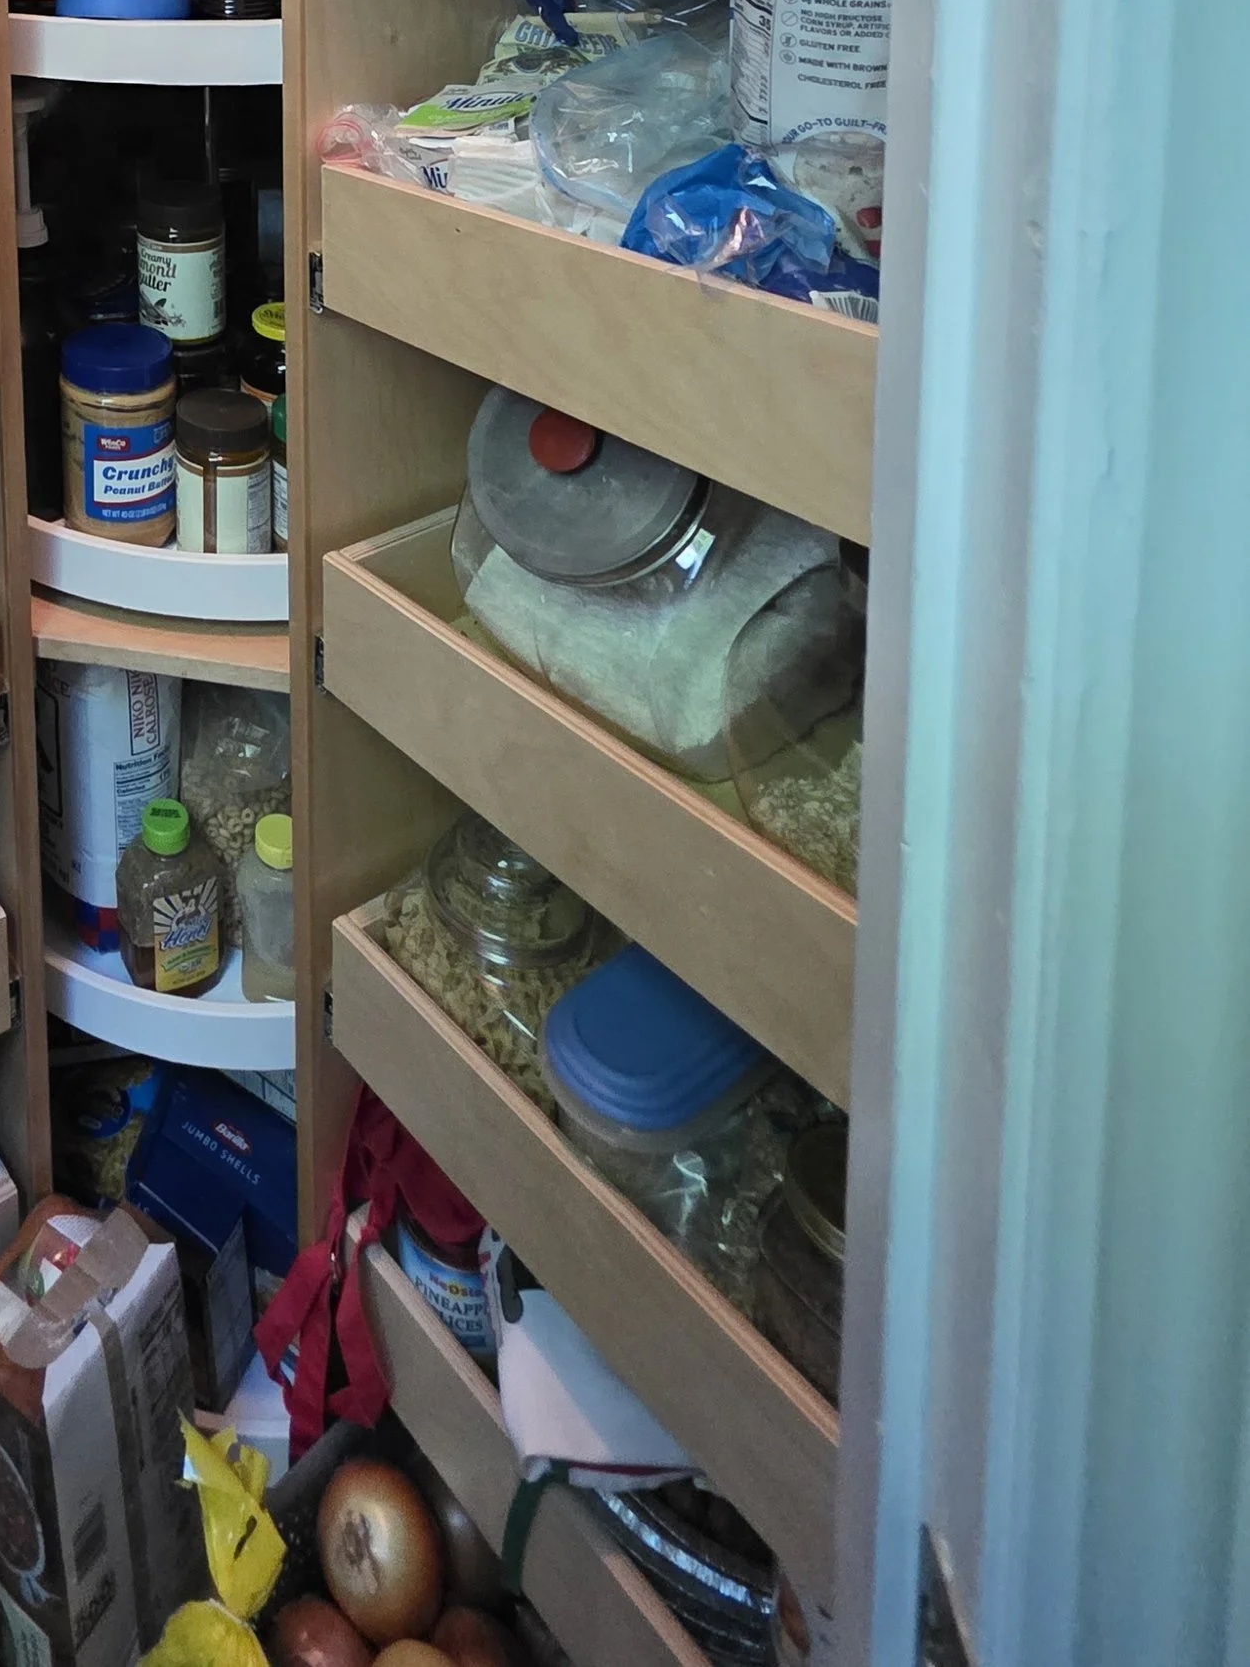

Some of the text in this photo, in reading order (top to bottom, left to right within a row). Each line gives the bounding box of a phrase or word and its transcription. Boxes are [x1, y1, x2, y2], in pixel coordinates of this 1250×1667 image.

[849, 0, 887, 9] GRAINS
[800, 9, 883, 23] NO HIGH FRUCTOSE
[800, 16, 823, 26] CORN
[800, 24, 838, 36] FLAVORS
[854, 30, 884, 38] ADDED
[799, 38, 861, 53] GLUTEN FREE
[798, 56, 888, 73] MADE WITH BROWN
[798, 74, 887, 90] CHOLESTEROL FREE
[799, 116, 834, 133] GO-TO
[141, 248, 172, 265] Creamy
[101, 437, 127, 447] WinCo
[102, 456, 174, 481] Crunchy
[103, 484, 145, 496] Peanut
[145, 673, 158, 745] CALROSE
[133, 700, 145, 739] NIKO
[116, 756, 153, 771] Nutrition
[117, 784, 146, 795] Calories
[215, 1122, 250, 1151] Barilla
[181, 1120, 262, 1185] JUMBO SHELLS
